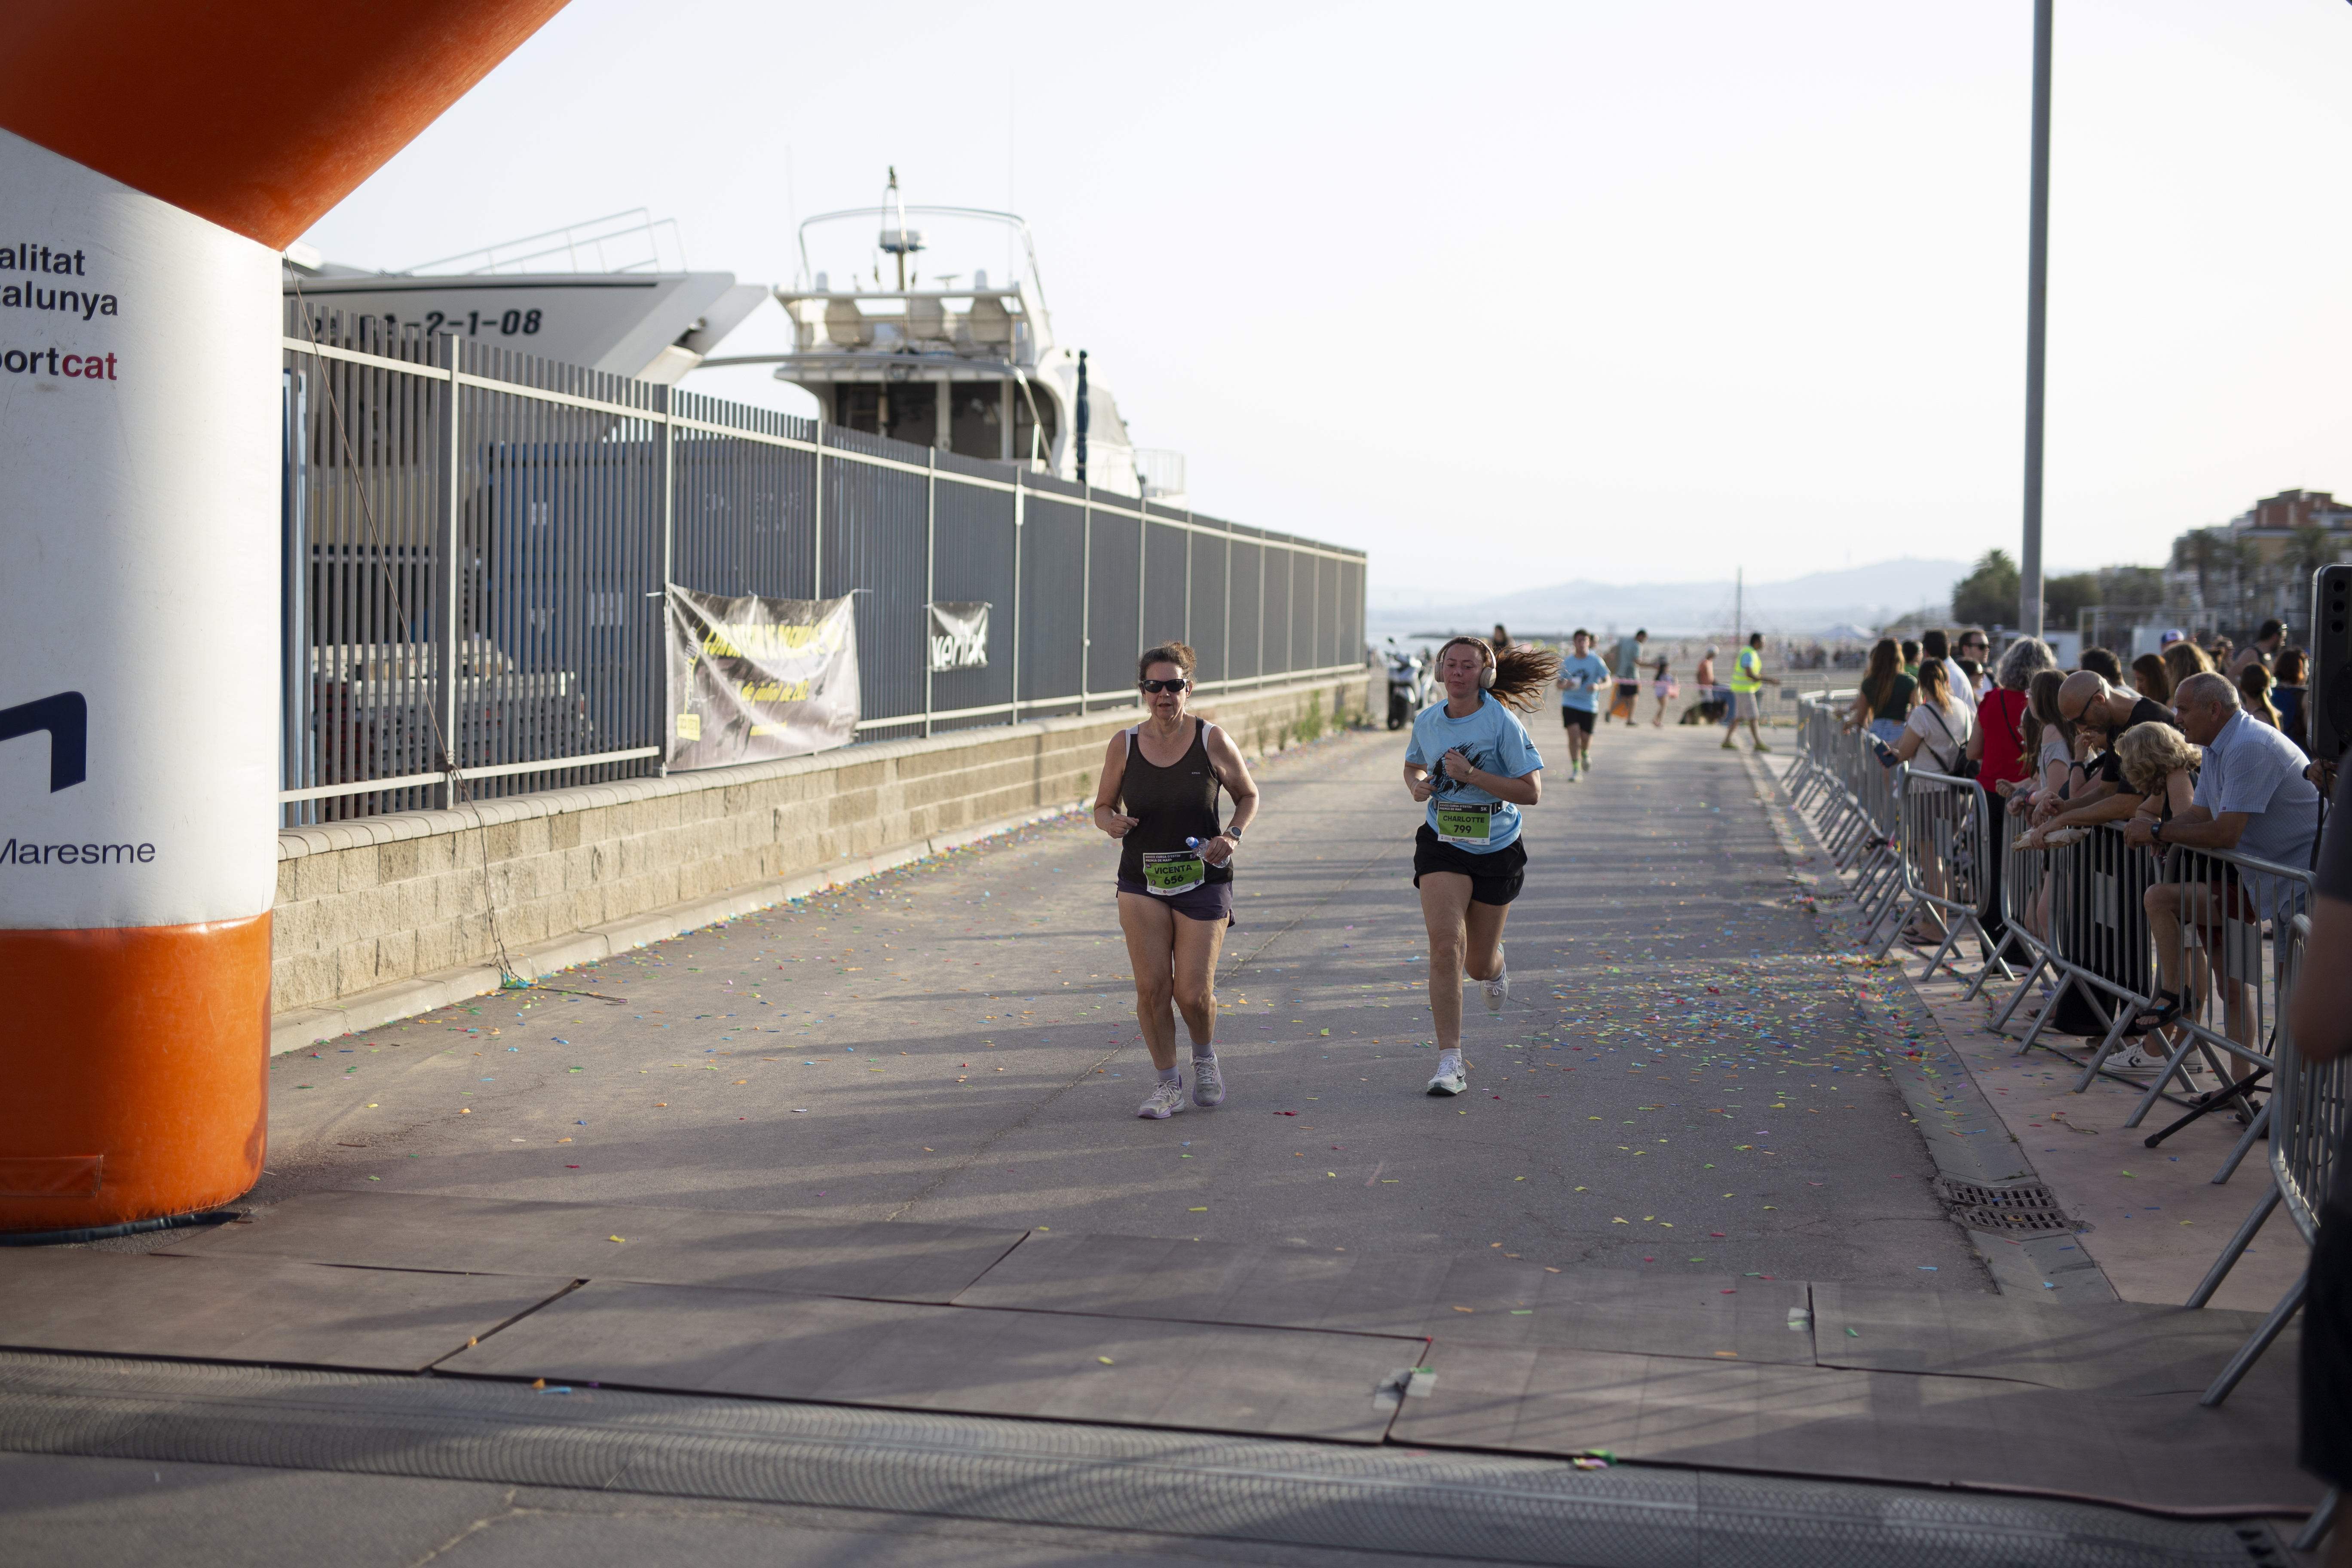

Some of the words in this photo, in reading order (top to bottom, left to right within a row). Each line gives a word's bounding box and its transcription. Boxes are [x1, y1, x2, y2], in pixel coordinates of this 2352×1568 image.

[0, 281, 119, 321] alunya
[0, 347, 118, 380] ortcat
[1454, 824, 1472, 833] 799
[1154, 864, 1192, 874] VICENTA
[1164, 875, 1184, 885] 656
